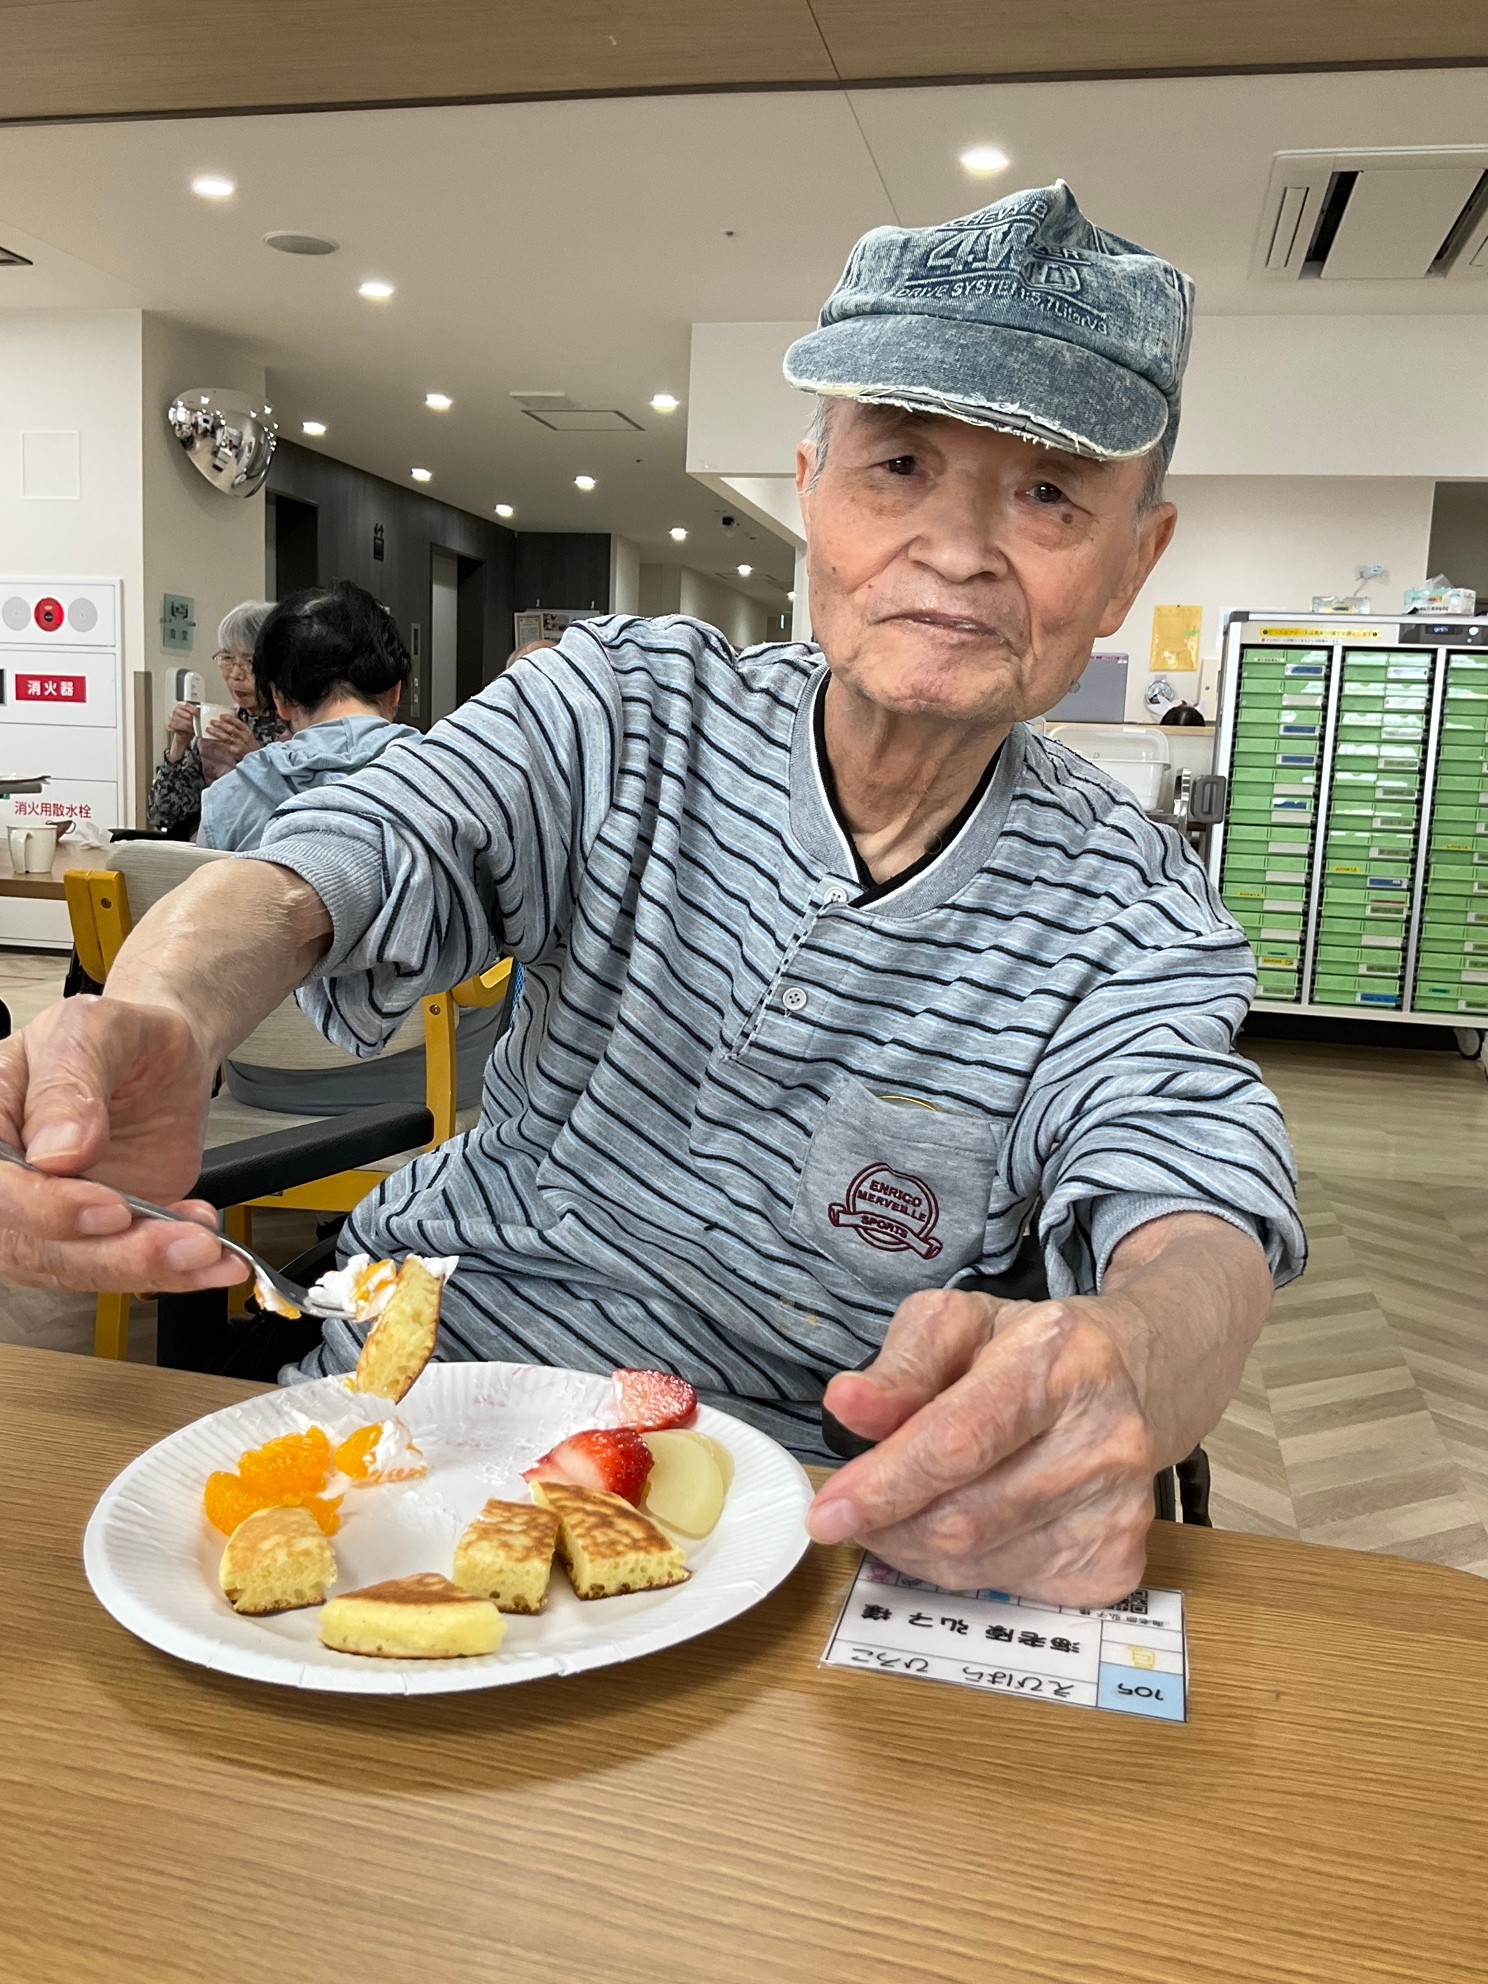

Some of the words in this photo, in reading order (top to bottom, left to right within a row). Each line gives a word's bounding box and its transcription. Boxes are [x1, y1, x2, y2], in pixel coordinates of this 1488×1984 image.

[950, 202, 1027, 227] CHEVY
[896, 284, 949, 298] DRIVE
[27, 680, 74, 697] 消火器
[14, 801, 92, 819] 消火用散水栓
[869, 1180, 922, 1207] ENRICO
[857, 1190, 927, 1222] MERVEILLE
[860, 1215, 909, 1238] SPORTS
[861, 1603, 892, 1621] 様
[851, 1647, 929, 1674] ひろこ
[962, 1665, 1075, 1698] えびはら
[1117, 1682, 1164, 1701] 105
